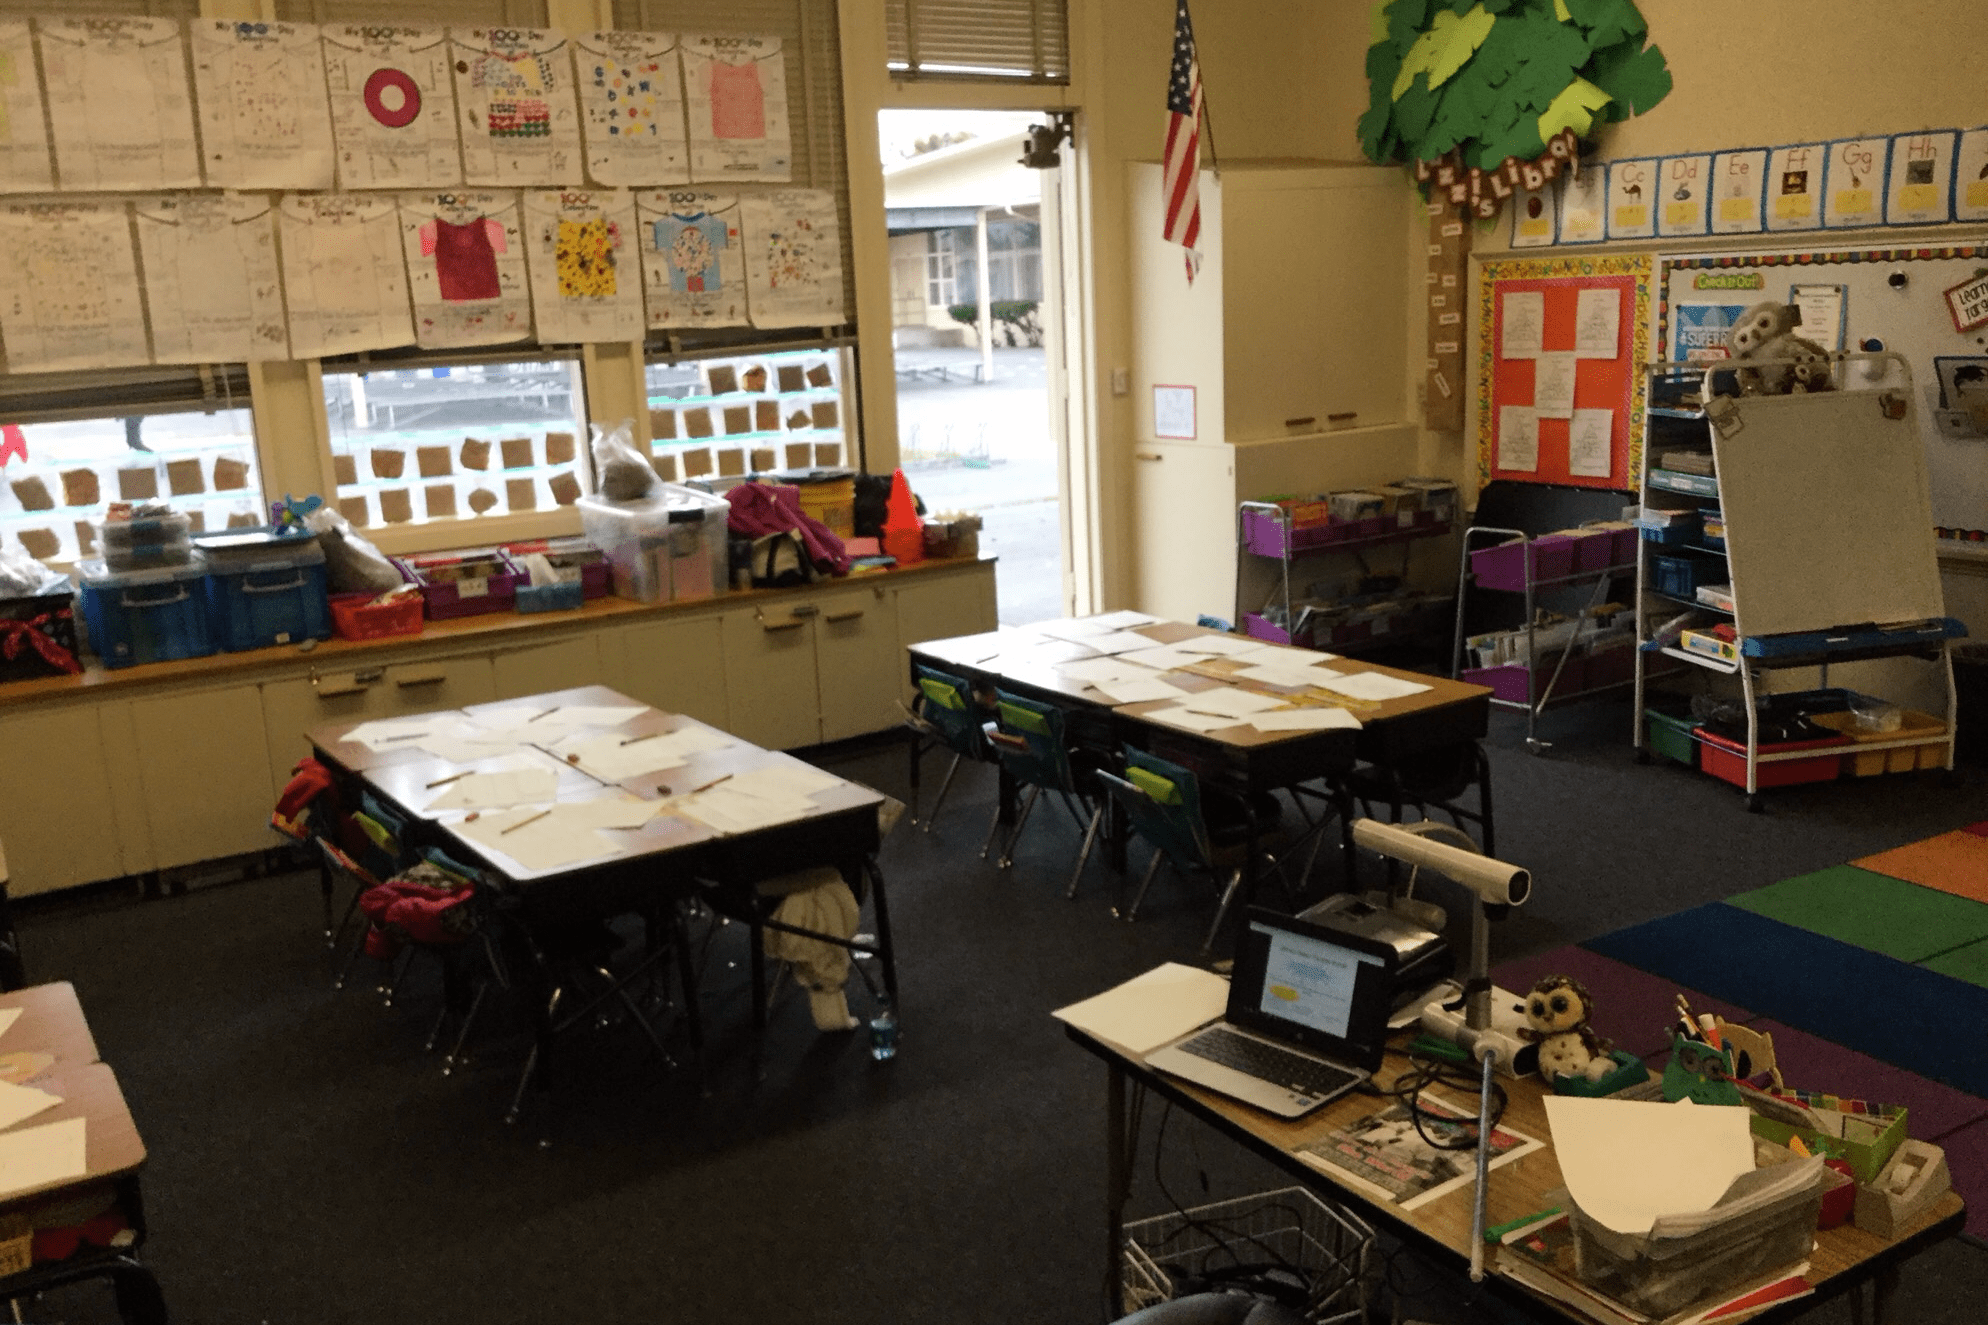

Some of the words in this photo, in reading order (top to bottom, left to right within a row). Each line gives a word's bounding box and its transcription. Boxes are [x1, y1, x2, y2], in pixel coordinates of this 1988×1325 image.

[1842, 143, 1872, 174] Gg
[1908, 137, 1937, 159] Hh
[1672, 159, 1698, 180] Dd
[1729, 155, 1750, 175] Ee
[1786, 149, 1811, 169] Ff
[1621, 164, 1645, 183] Cc
[1418, 155, 1496, 218] Lzzi's
